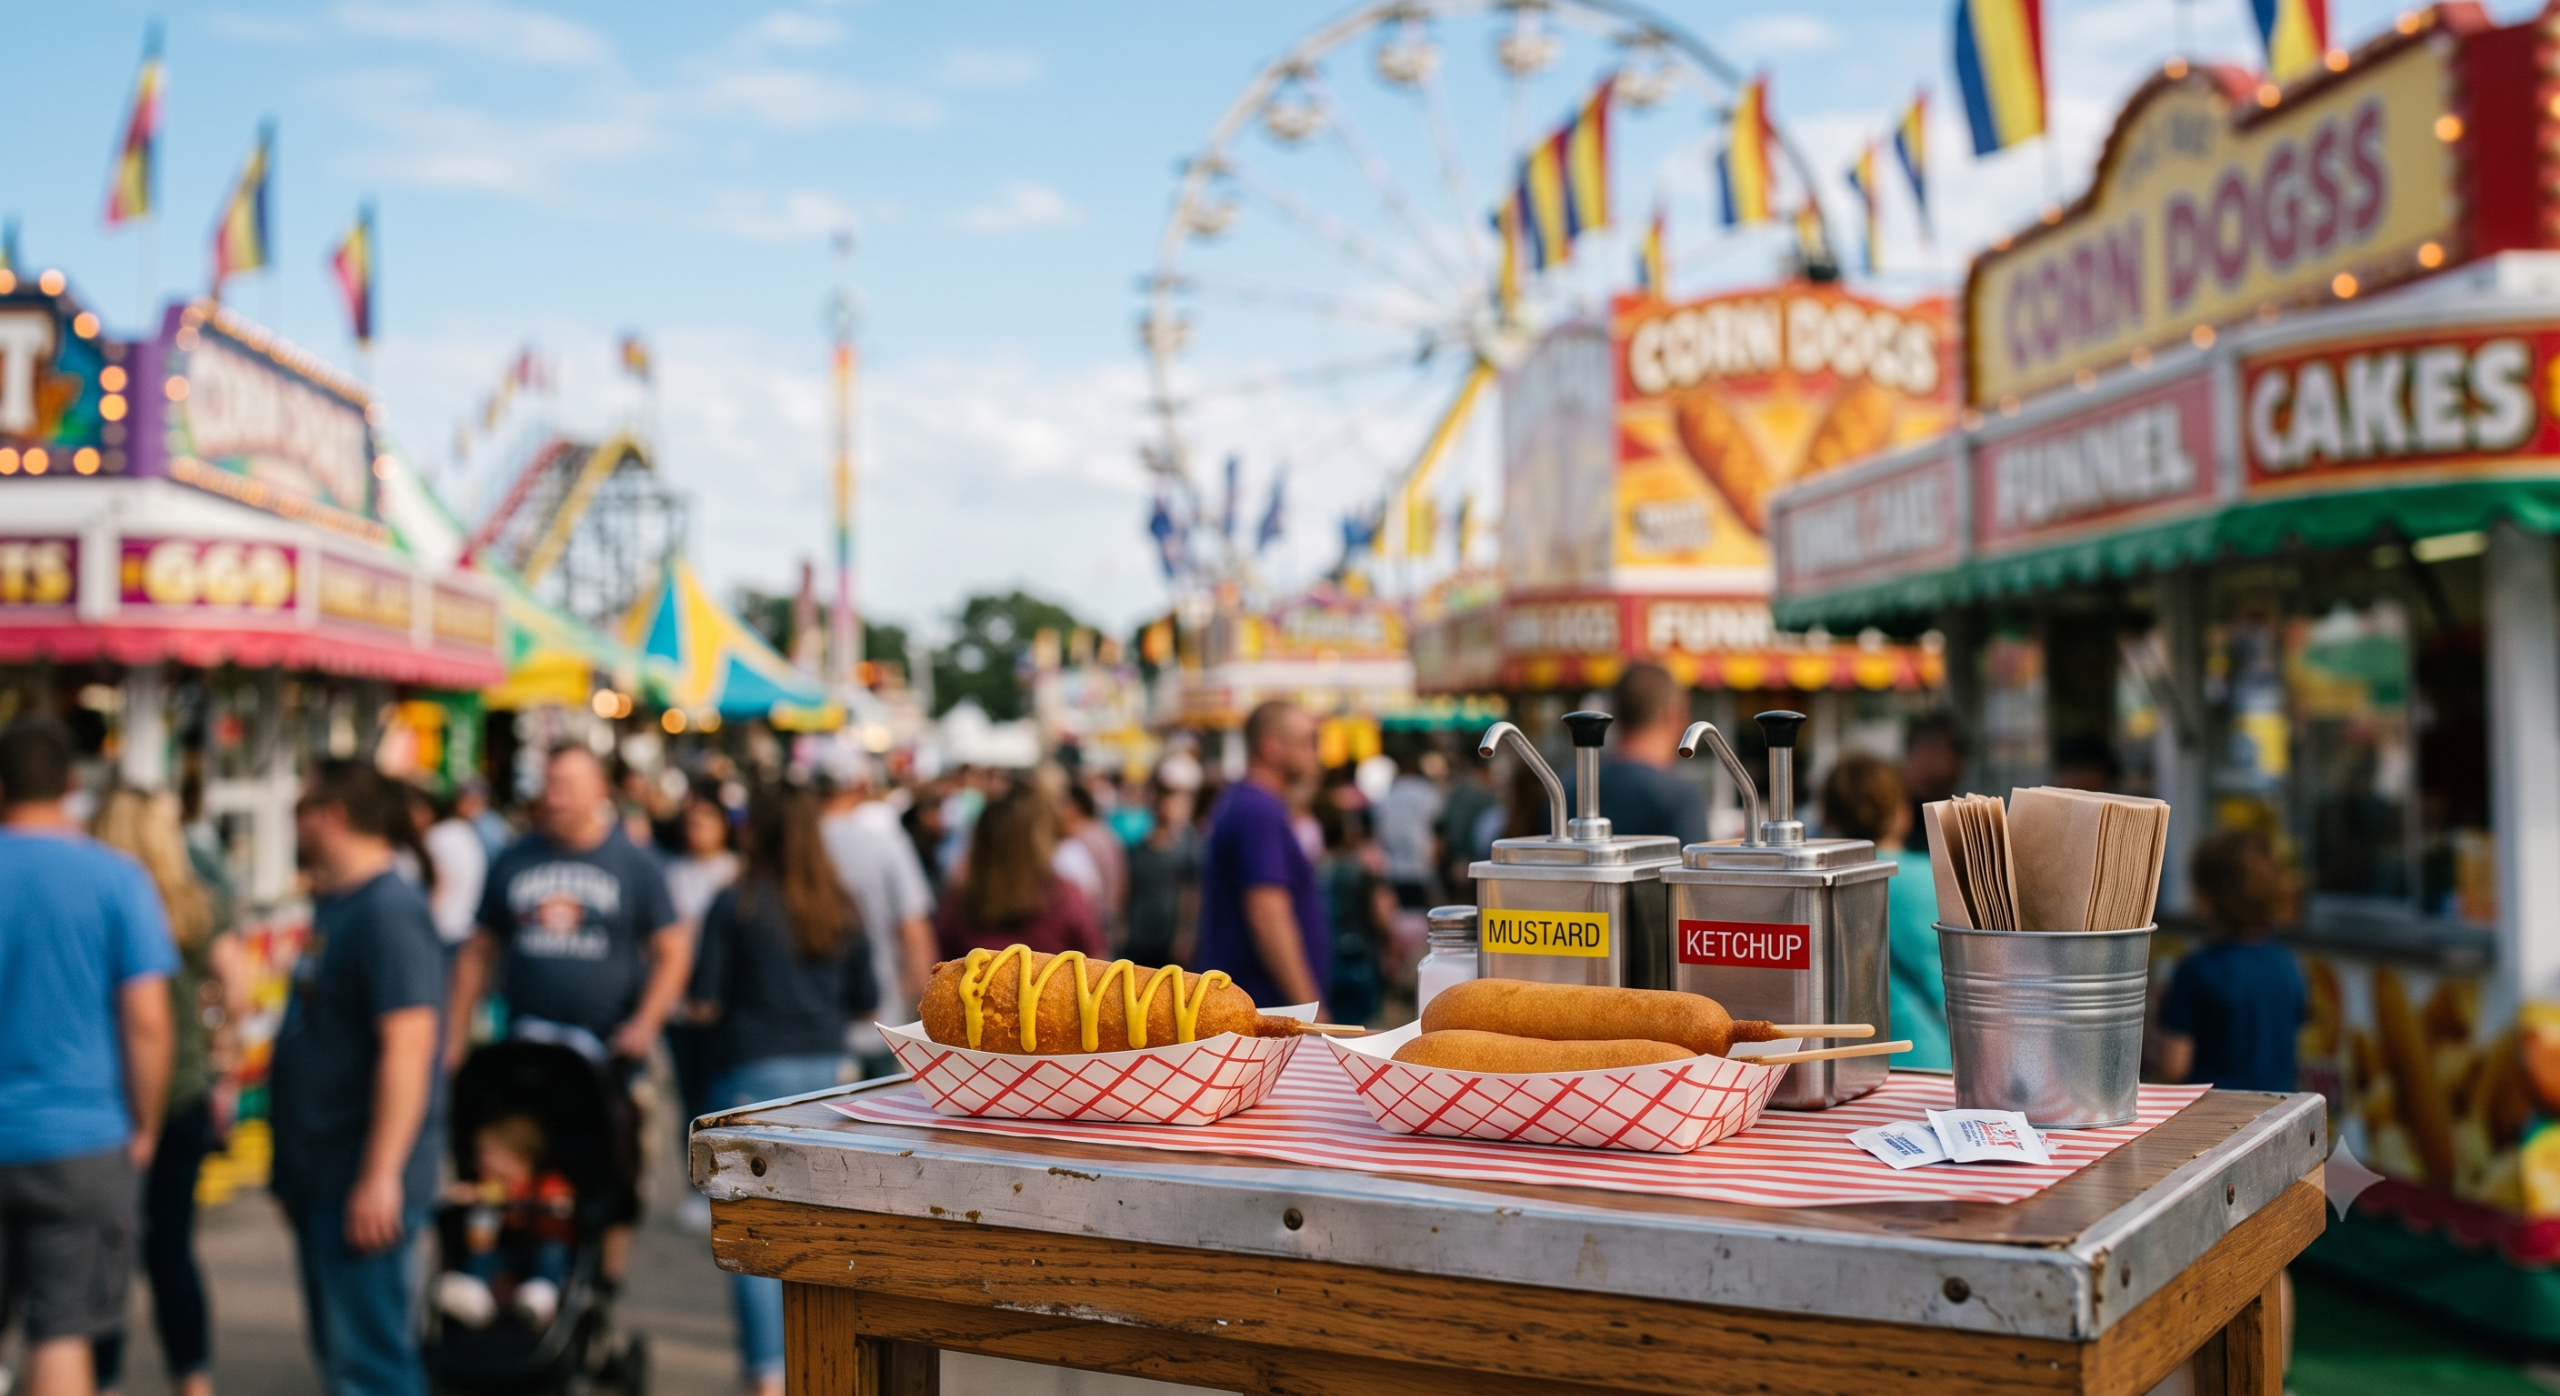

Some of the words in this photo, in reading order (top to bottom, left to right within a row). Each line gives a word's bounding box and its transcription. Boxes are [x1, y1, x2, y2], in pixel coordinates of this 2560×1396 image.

[2006, 214, 2142, 371] CORN
[2166, 96, 2388, 312] DOGSS
[1630, 302, 1778, 394] CORN
[1788, 296, 1938, 394] DOGS
[2251, 338, 2535, 472] CAKES
[1997, 405, 2195, 532] FUNNEL
[1648, 602, 1776, 654] FUNN
[1487, 919, 1602, 948] MUSTARD
[1686, 929, 1803, 961] KETCHUP
